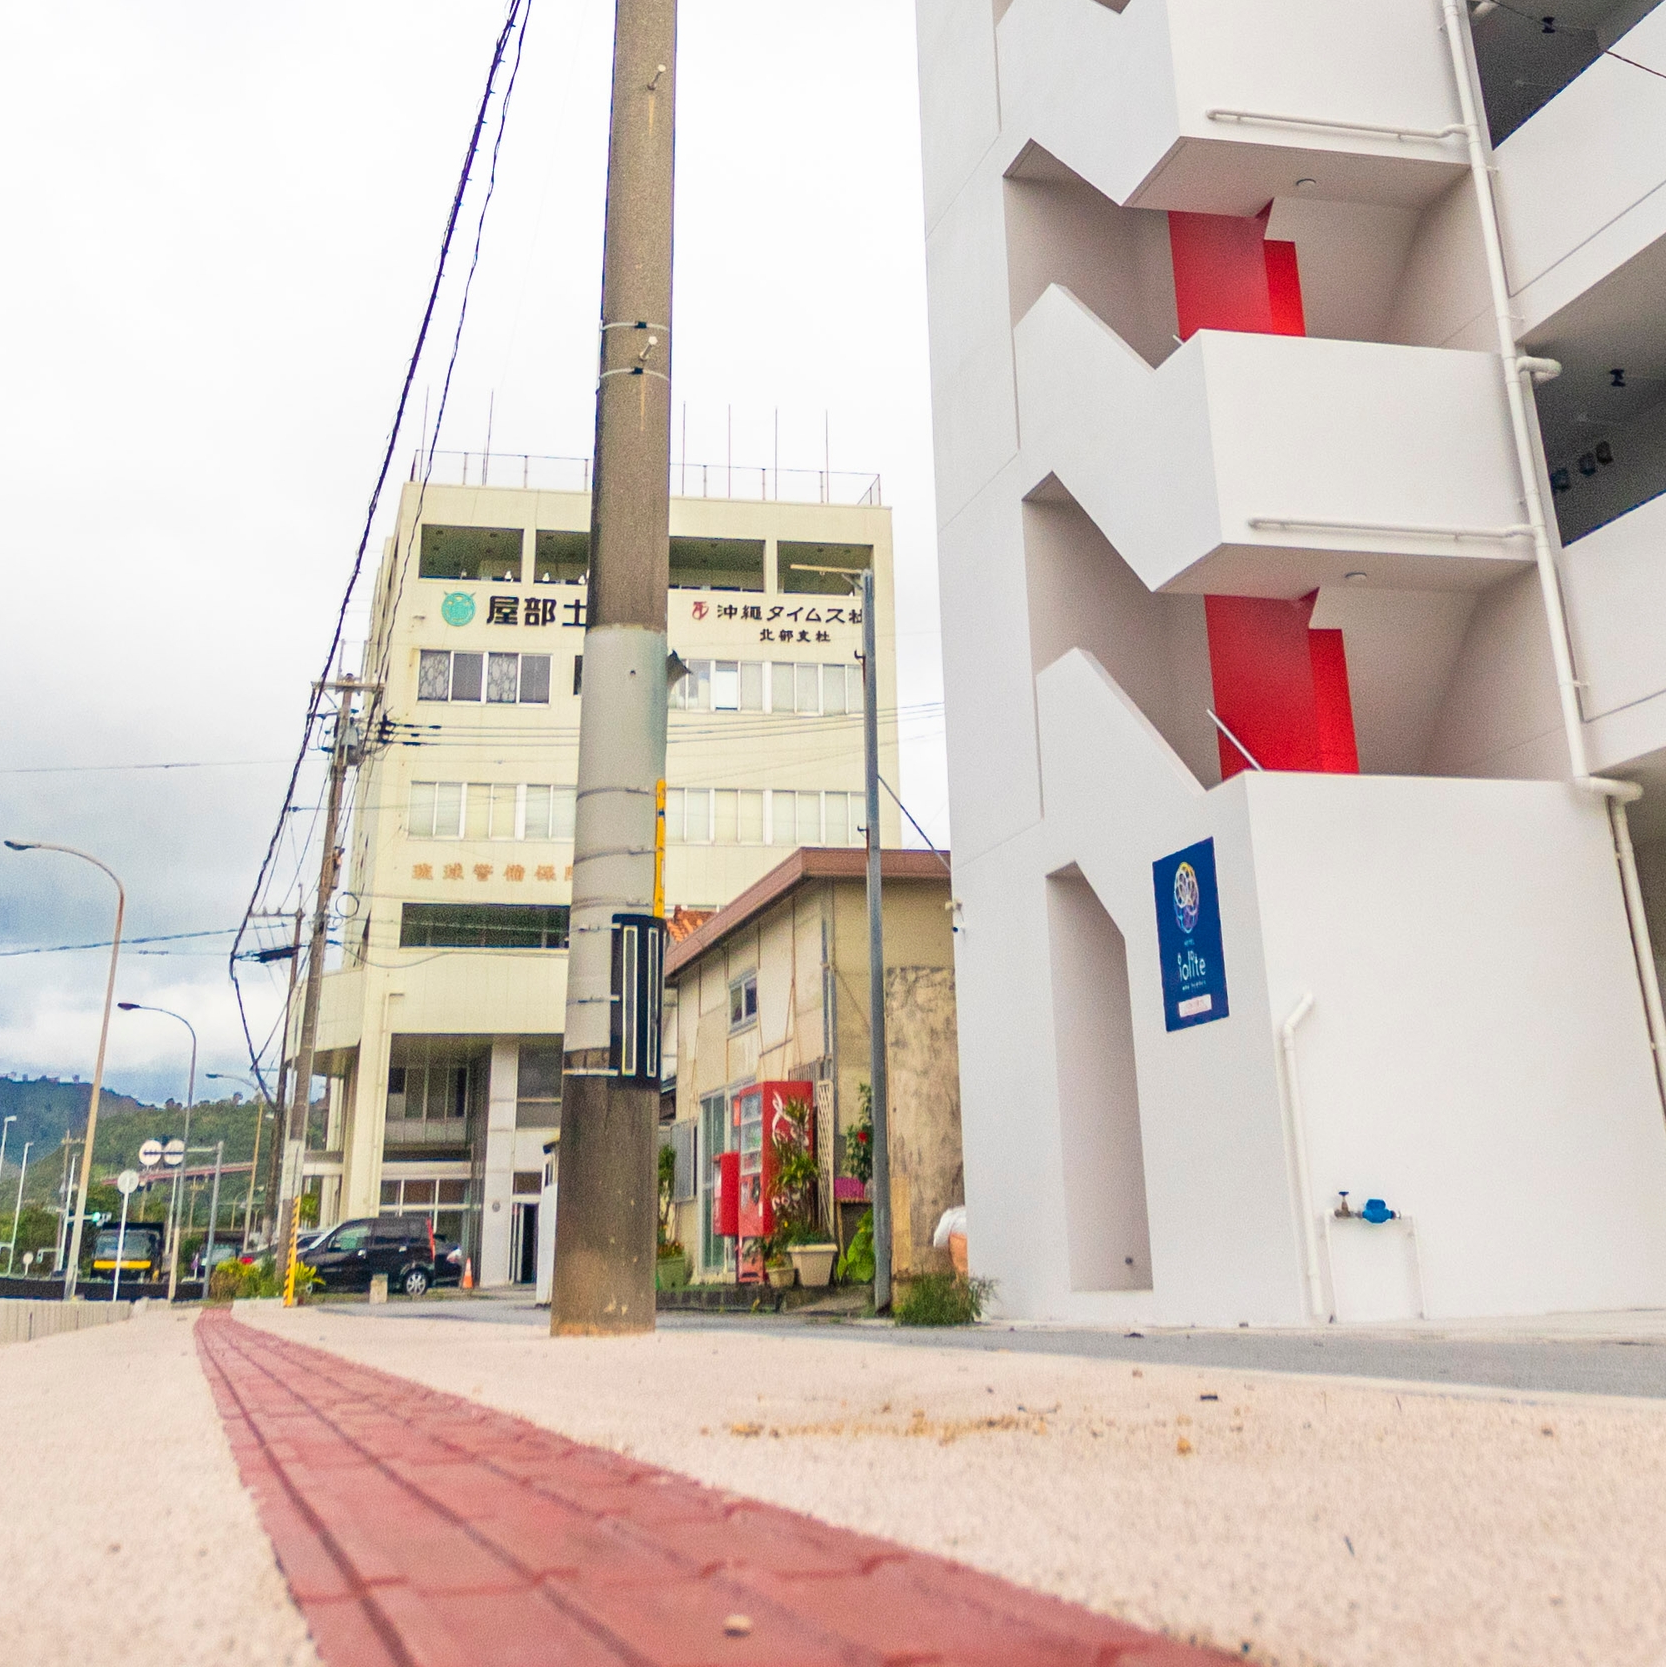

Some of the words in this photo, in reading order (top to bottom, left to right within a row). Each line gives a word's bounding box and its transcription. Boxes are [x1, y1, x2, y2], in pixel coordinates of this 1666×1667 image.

[760, 628, 831, 643] 北部支社
[1177, 950, 1206, 982] iolite
